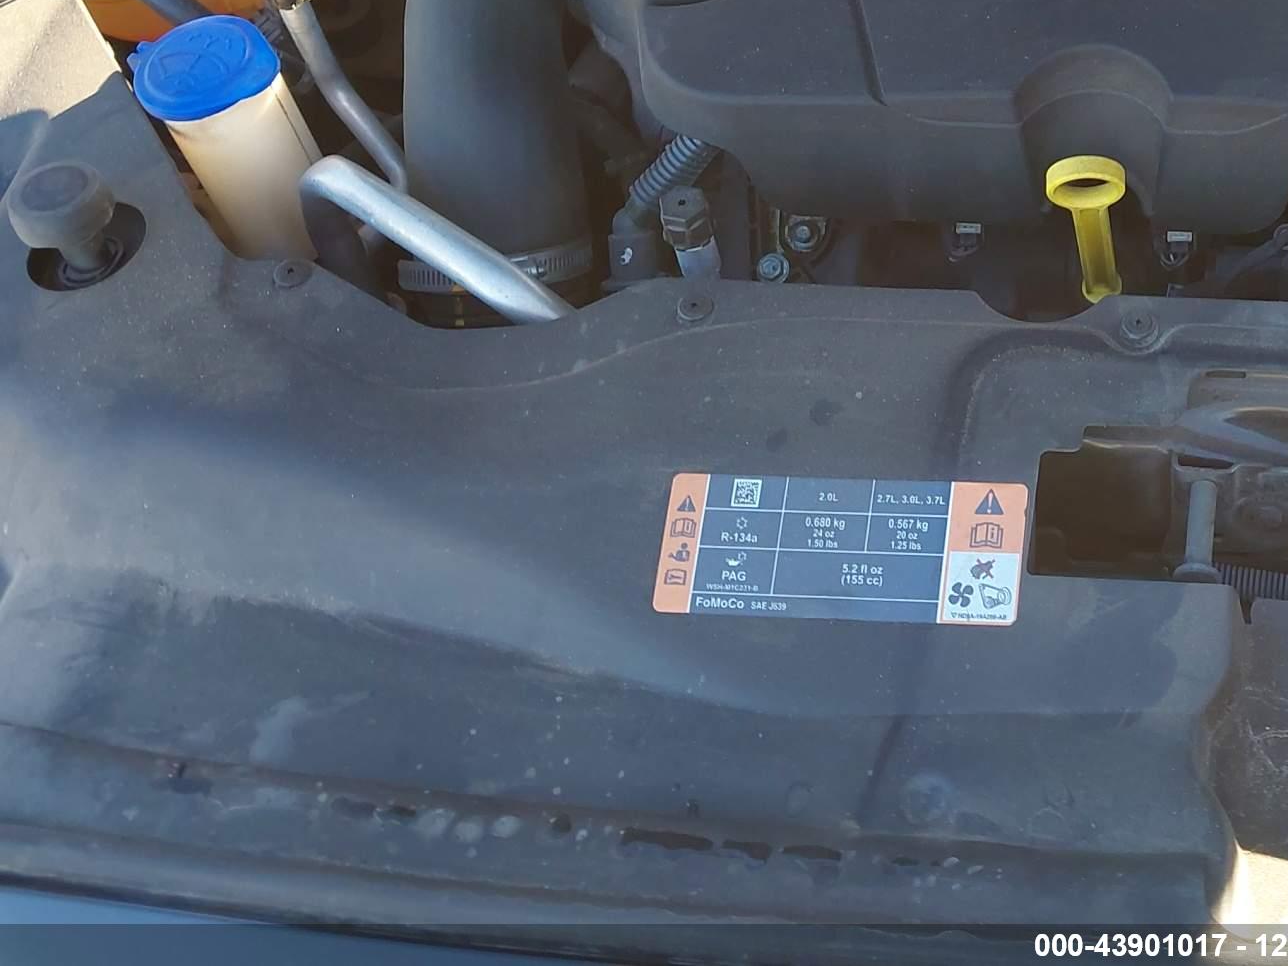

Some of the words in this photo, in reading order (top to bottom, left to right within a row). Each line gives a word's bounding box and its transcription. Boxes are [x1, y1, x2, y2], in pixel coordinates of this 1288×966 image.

[818, 492, 839, 502] 2.0L
[877, 494, 899, 504] 2.7L,
[926, 496, 946, 505] 3.7L
[805, 516, 831, 527] 0.680
[833, 517, 846, 530] kg
[888, 518, 915, 529] 0.567
[916, 519, 929, 532] kg
[721, 532, 758, 543] R-134a
[813, 528, 823, 537] 24
[824, 530, 835, 538] oz
[896, 530, 907, 539] 20
[907, 532, 918, 540] oz
[807, 538, 824, 548] 1.50
[825, 539, 838, 548] lbs
[891, 540, 907, 550] 1.25
[908, 541, 921, 550] lbs
[842, 563, 858, 573] 5.2
[860, 564, 868, 574] fl
[870, 566, 883, 574] oz
[721, 570, 747, 581] PAG
[841, 574, 864, 586] (155
[866, 575, 883, 586] cc)
[695, 596, 745, 609] FoMoCo
[751, 601, 768, 610] SAE
